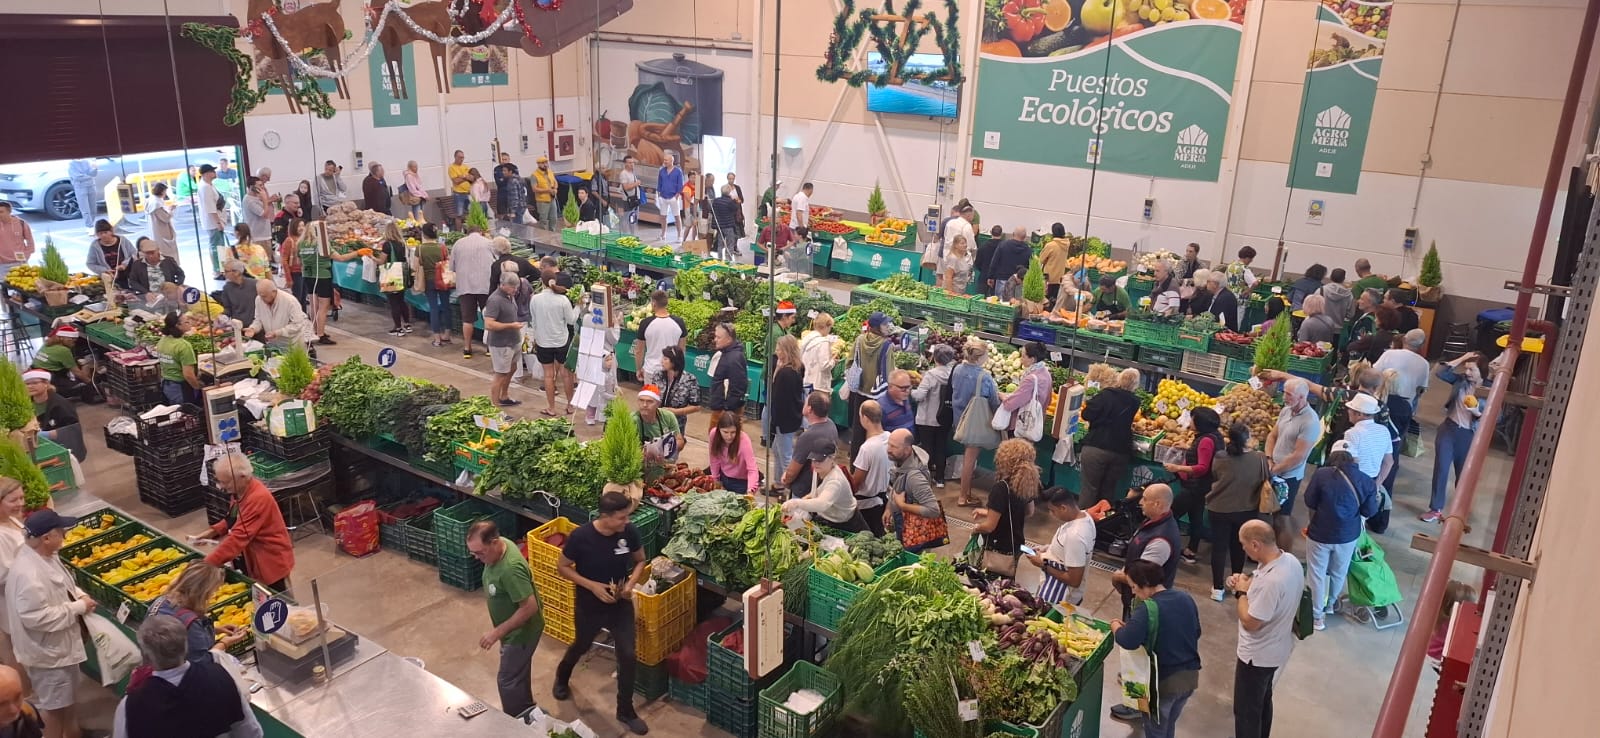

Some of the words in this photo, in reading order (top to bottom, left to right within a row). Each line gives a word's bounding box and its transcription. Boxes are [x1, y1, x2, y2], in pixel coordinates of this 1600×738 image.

[1048, 69, 1148, 97] Puestos
[1018, 96, 1174, 135] Ecológicos
[1313, 127, 1349, 139] AGRO
[1175, 144, 1207, 155] AGRO
